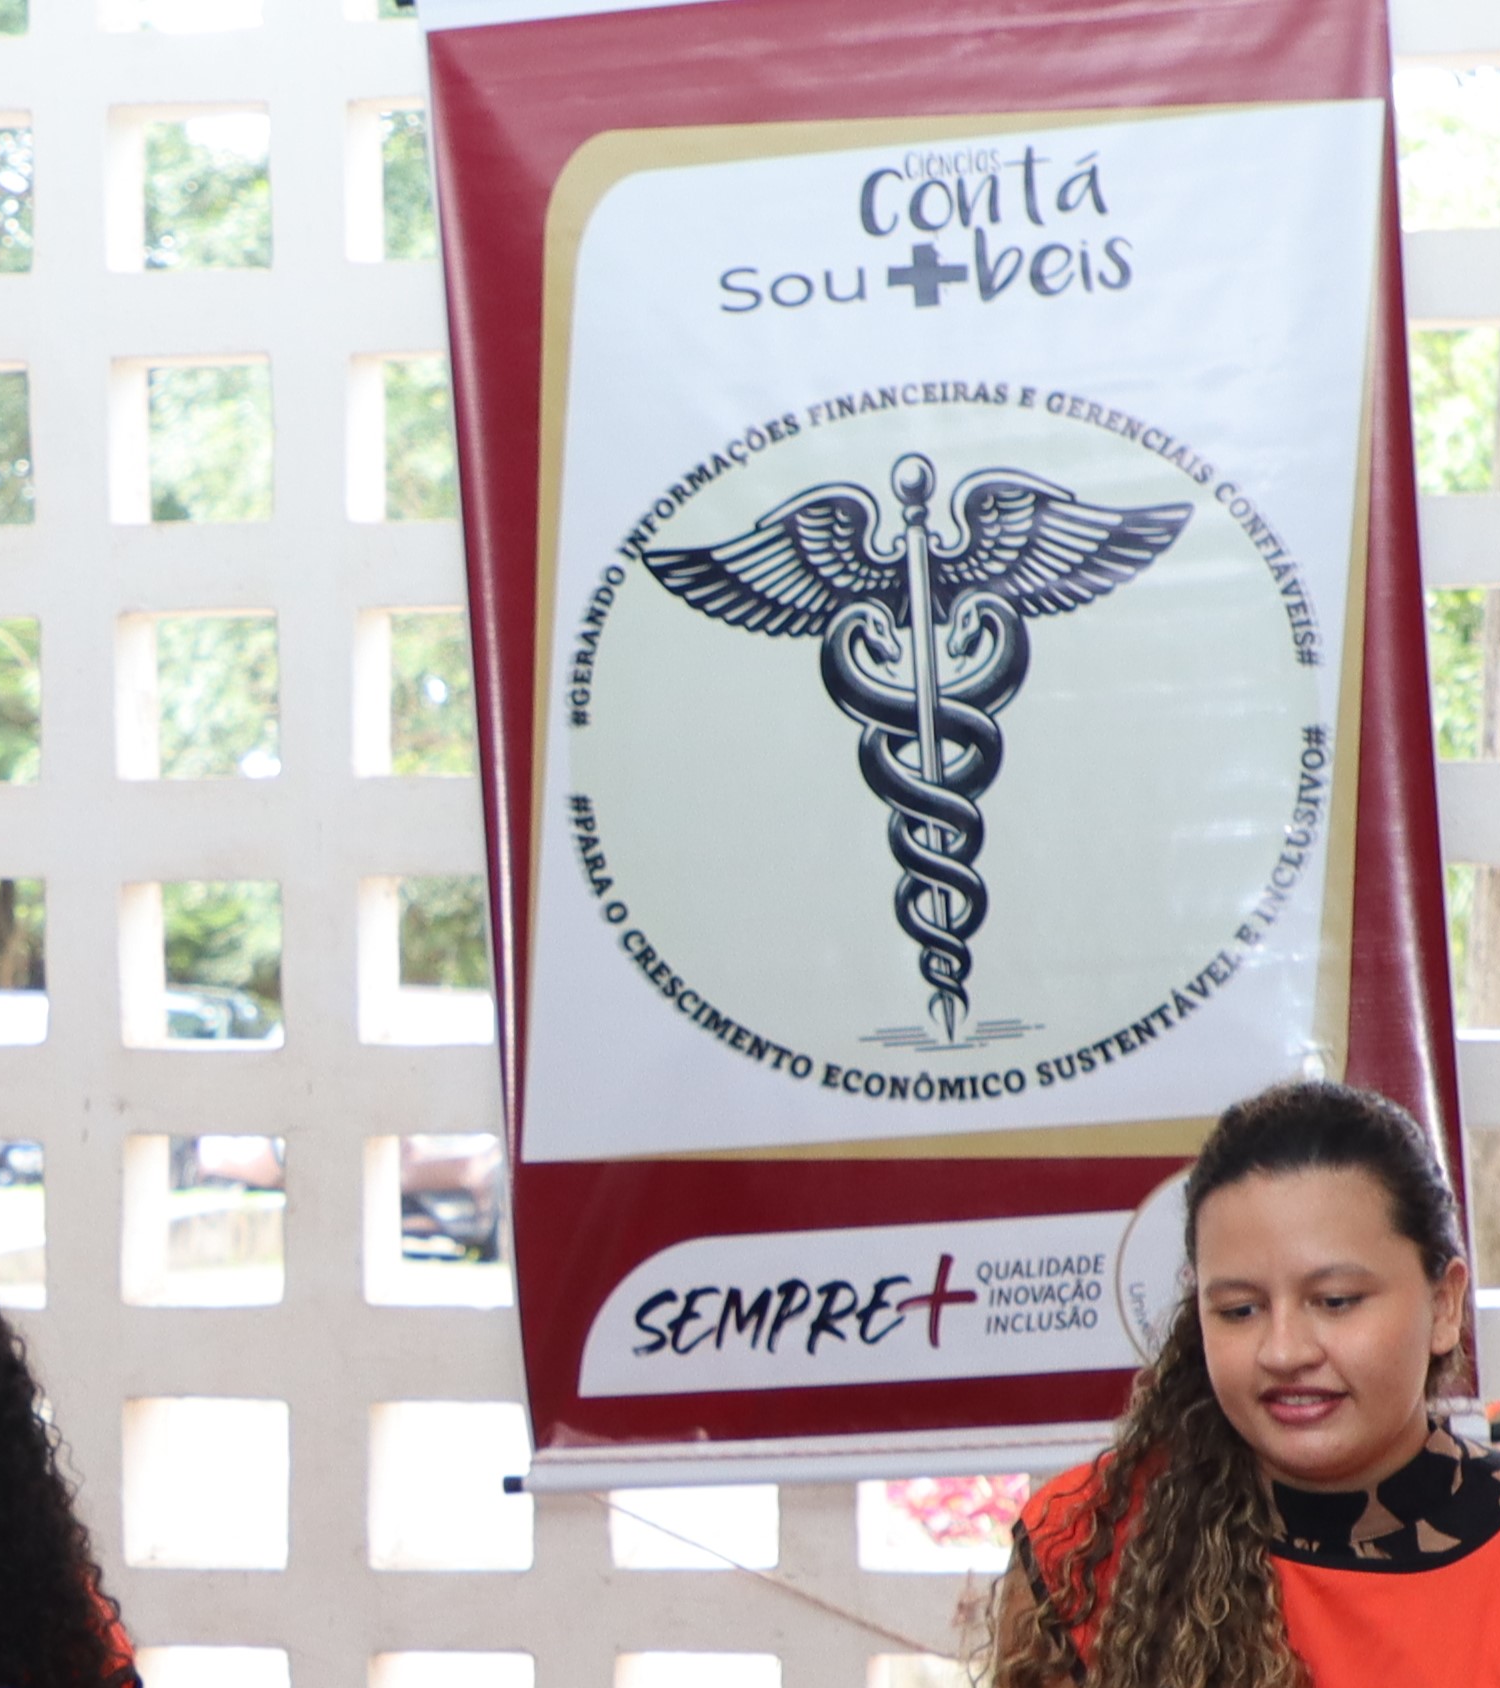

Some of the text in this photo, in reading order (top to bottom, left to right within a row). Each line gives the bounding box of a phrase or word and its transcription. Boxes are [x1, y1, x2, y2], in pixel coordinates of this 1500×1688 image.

[720, 265, 867, 312] Sou
[570, 381, 1323, 727] #GERANDO INFORMAÇÕES FINANCEIRAS E GERENCIAIS CONFIÁVEIS#
[567, 723, 1327, 1102] #PARA O CRESCIMENTO ECONÔMICO SUSTENTÁVEL E INCLUSIVO#
[976, 1254, 1106, 1285] QUALIDADE
[988, 1278, 1103, 1310] INOVAÇÃO
[984, 1305, 1099, 1336] INCLUSÃO
